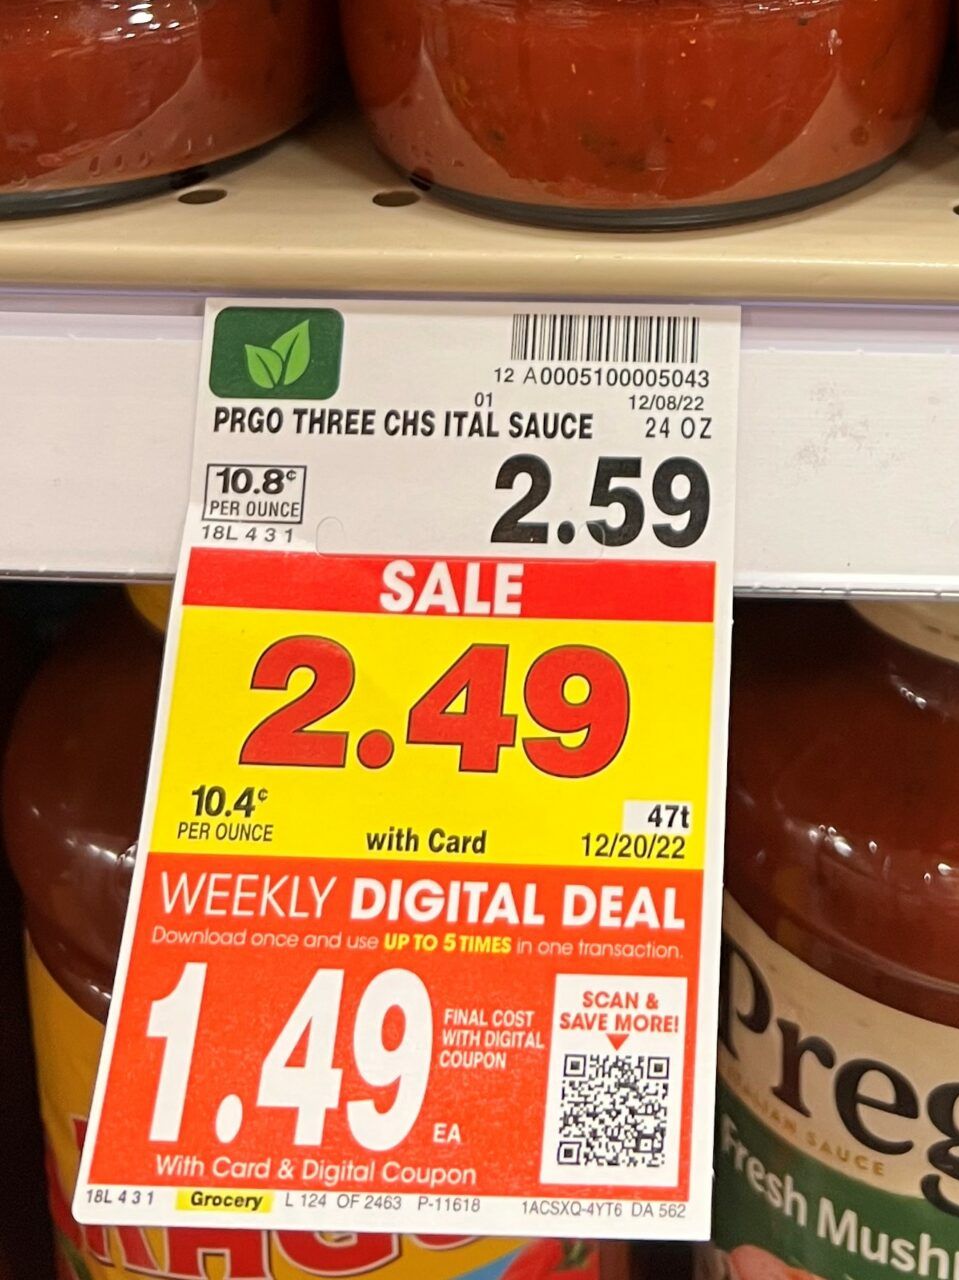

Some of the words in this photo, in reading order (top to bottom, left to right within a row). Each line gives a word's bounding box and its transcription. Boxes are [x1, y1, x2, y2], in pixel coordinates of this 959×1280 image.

[494, 368, 514, 383] 12
[523, 366, 710, 388] A0005100005043
[474, 393, 494, 407] 01
[629, 395, 704, 411] 12/08/22
[213, 406, 284, 434] PRGO
[293, 408, 376, 435] THREE
[384, 410, 436, 438] CHS
[443, 410, 500, 438] ITAL
[508, 411, 594, 440] SAUCE
[645, 417, 671, 438] 24
[209, 500, 240, 516] PER
[246, 501, 300, 518] OUNCE
[490, 453, 710, 549] 2.59
[201, 525, 239, 542] 18L
[245, 527, 257, 541] 4
[264, 527, 277, 543] 3
[285, 528, 294, 544] 1
[378, 559, 523, 615] SALE
[238, 634, 631, 779] 2.49
[647, 804, 690, 829] 47t
[177, 821, 210, 840] PER
[215, 822, 274, 842] OUNCE
[366, 827, 420, 852] with
[428, 828, 488, 854] Card
[581, 832, 686, 859] 12/20/22
[161, 871, 337, 918] WEEKLY
[350, 876, 545, 926] DIGITAL
[562, 884, 686, 930] DEAL
[151, 925, 247, 945] Download
[251, 933, 299, 947] once
[304, 931, 342, 948] and
[347, 937, 379, 950] use
[384, 933, 410, 950] UP
[413, 934, 439, 952] TO
[443, 933, 457, 951] 5
[459, 935, 512, 954] TIMES
[517, 939, 533, 955] in
[538, 942, 574, 955] one
[578, 939, 684, 959] transaction.
[582, 991, 640, 1010] SCAN
[646, 992, 659, 1010] &
[444, 1009, 488, 1026] FINAL
[493, 1010, 535, 1027] COST
[559, 1012, 608, 1031] SAVE
[614, 1014, 679, 1033] MORE!
[441, 1029, 481, 1047] WITH
[484, 1031, 545, 1049] DIGITAL
[146, 961, 434, 1152] 1.49
[439, 1049, 507, 1070] COUPON
[433, 1122, 461, 1144] EA
[806, 1131, 885, 1176] SAUCE
[155, 1153, 205, 1177] With
[211, 1155, 270, 1180] Card
[279, 1159, 294, 1181] &
[302, 1157, 376, 1186] Digital
[382, 1161, 477, 1188] Coupon
[720, 1114, 807, 1227] Fresh
[85, 1189, 112, 1204] 18L
[117, 1190, 127, 1204] 4
[132, 1191, 142, 1204] 3
[147, 1191, 154, 1205] 1
[190, 1191, 263, 1211] Grocery
[285, 1193, 294, 1208] L
[301, 1194, 327, 1208] 124
[336, 1194, 361, 1209] OF
[364, 1194, 402, 1210] 2463
[418, 1196, 481, 1213] P-11618
[522, 1200, 623, 1217] 1ACSXQ-4YT6
[631, 1202, 654, 1218] DA
[659, 1203, 686, 1218] 562
